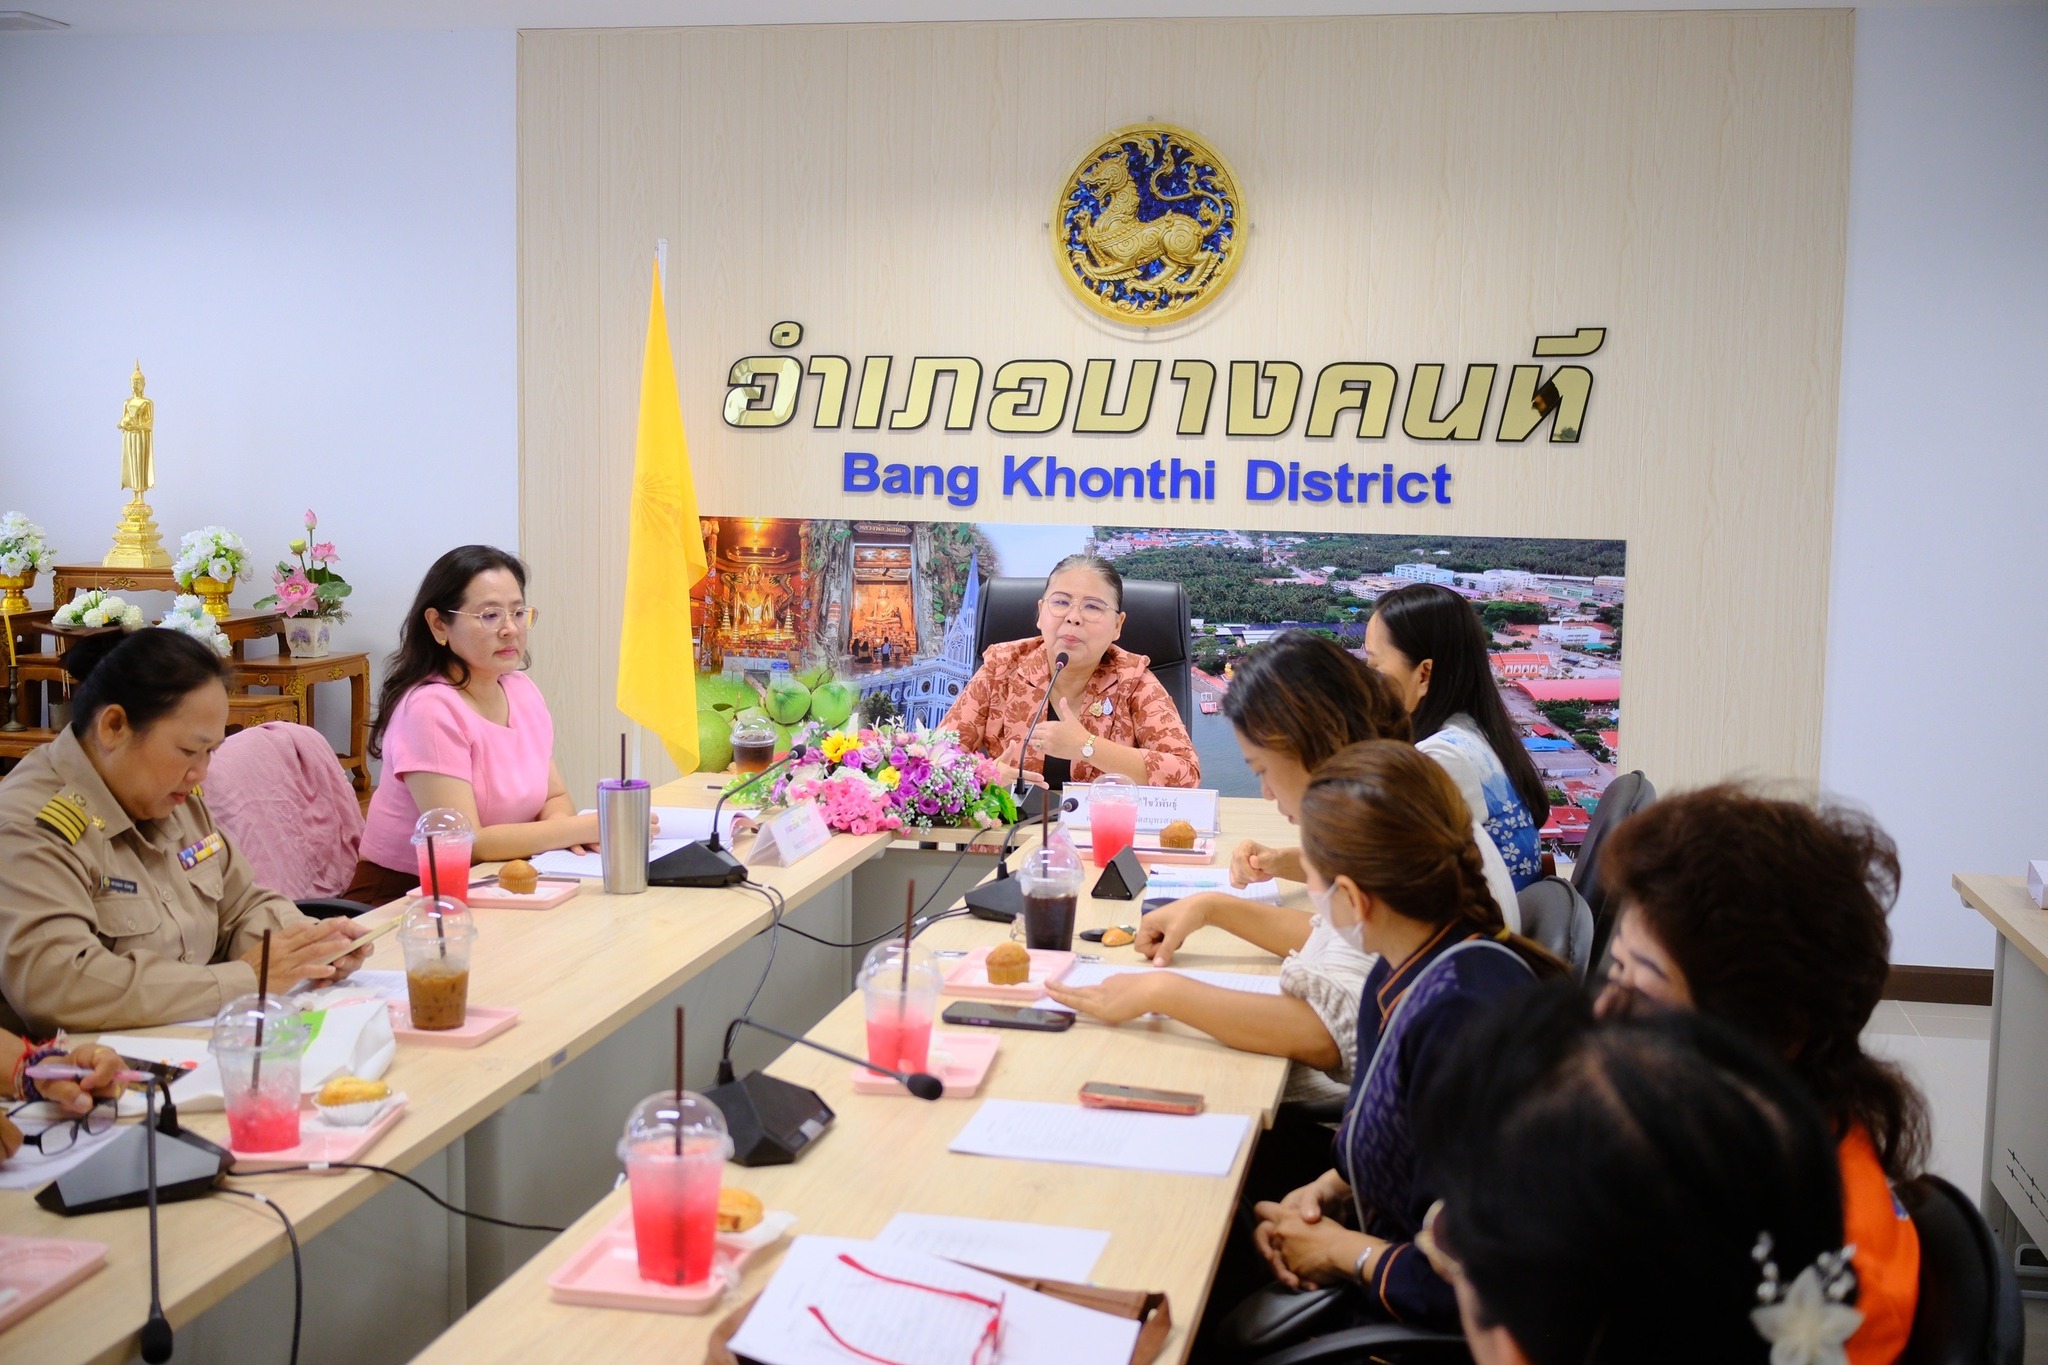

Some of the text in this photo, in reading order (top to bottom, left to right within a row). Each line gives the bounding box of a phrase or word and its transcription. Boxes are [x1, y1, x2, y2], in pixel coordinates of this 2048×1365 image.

[723, 320, 1607, 443] อำเภอบางคนที
[843, 452, 1451, 506] Bang Khonthi District
